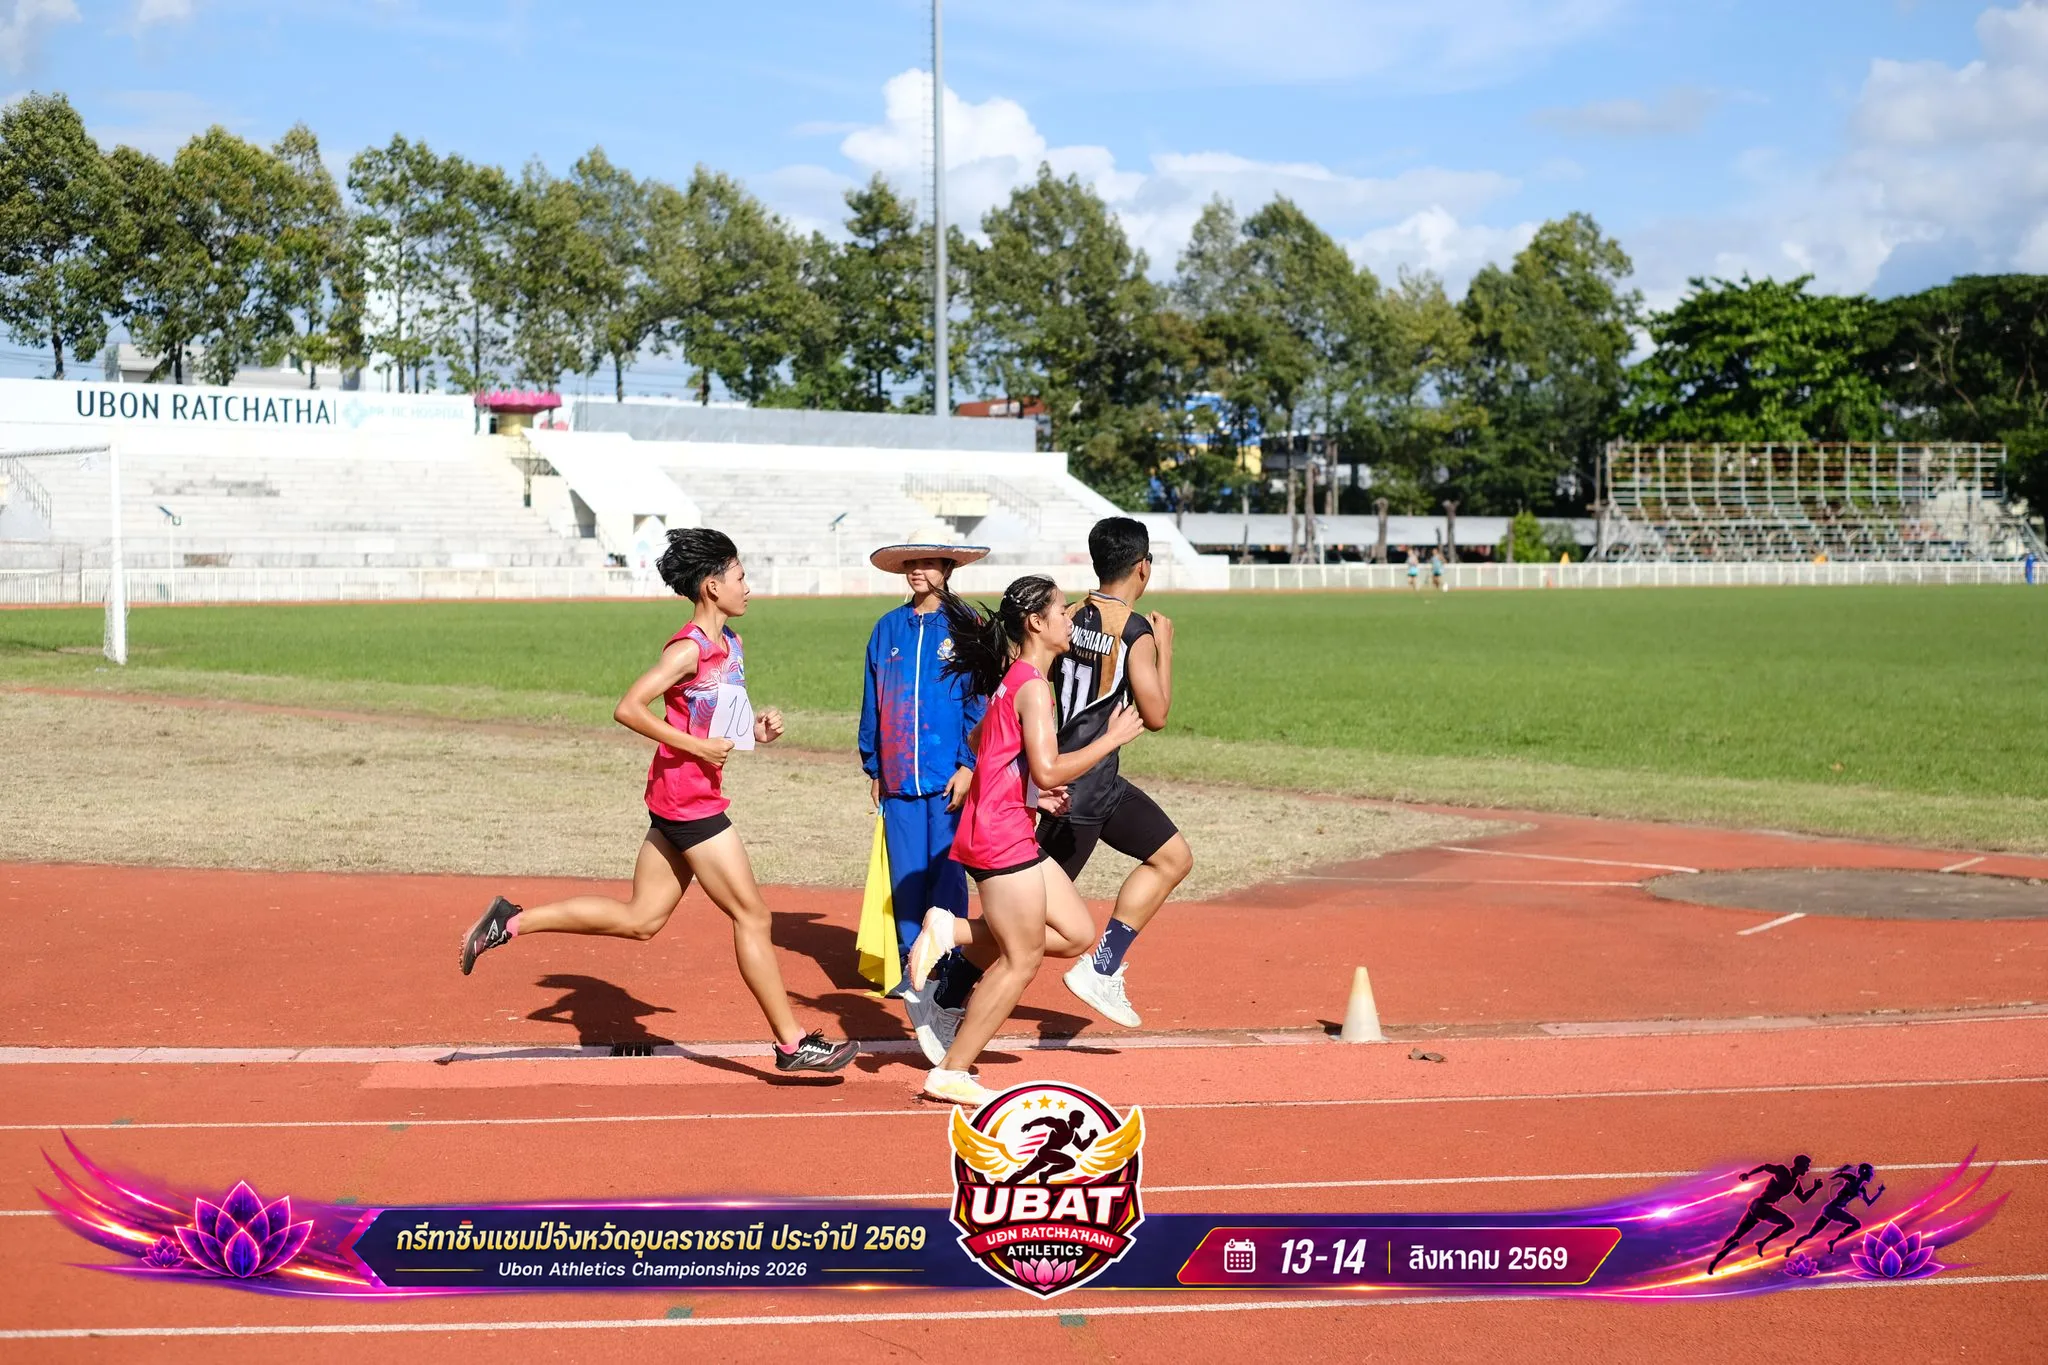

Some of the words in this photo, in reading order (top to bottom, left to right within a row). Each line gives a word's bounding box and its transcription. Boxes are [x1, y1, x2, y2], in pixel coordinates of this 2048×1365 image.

[77, 390, 159, 420] UBON
[1060, 657, 1093, 726] 11
[723, 695, 751, 738] 10
